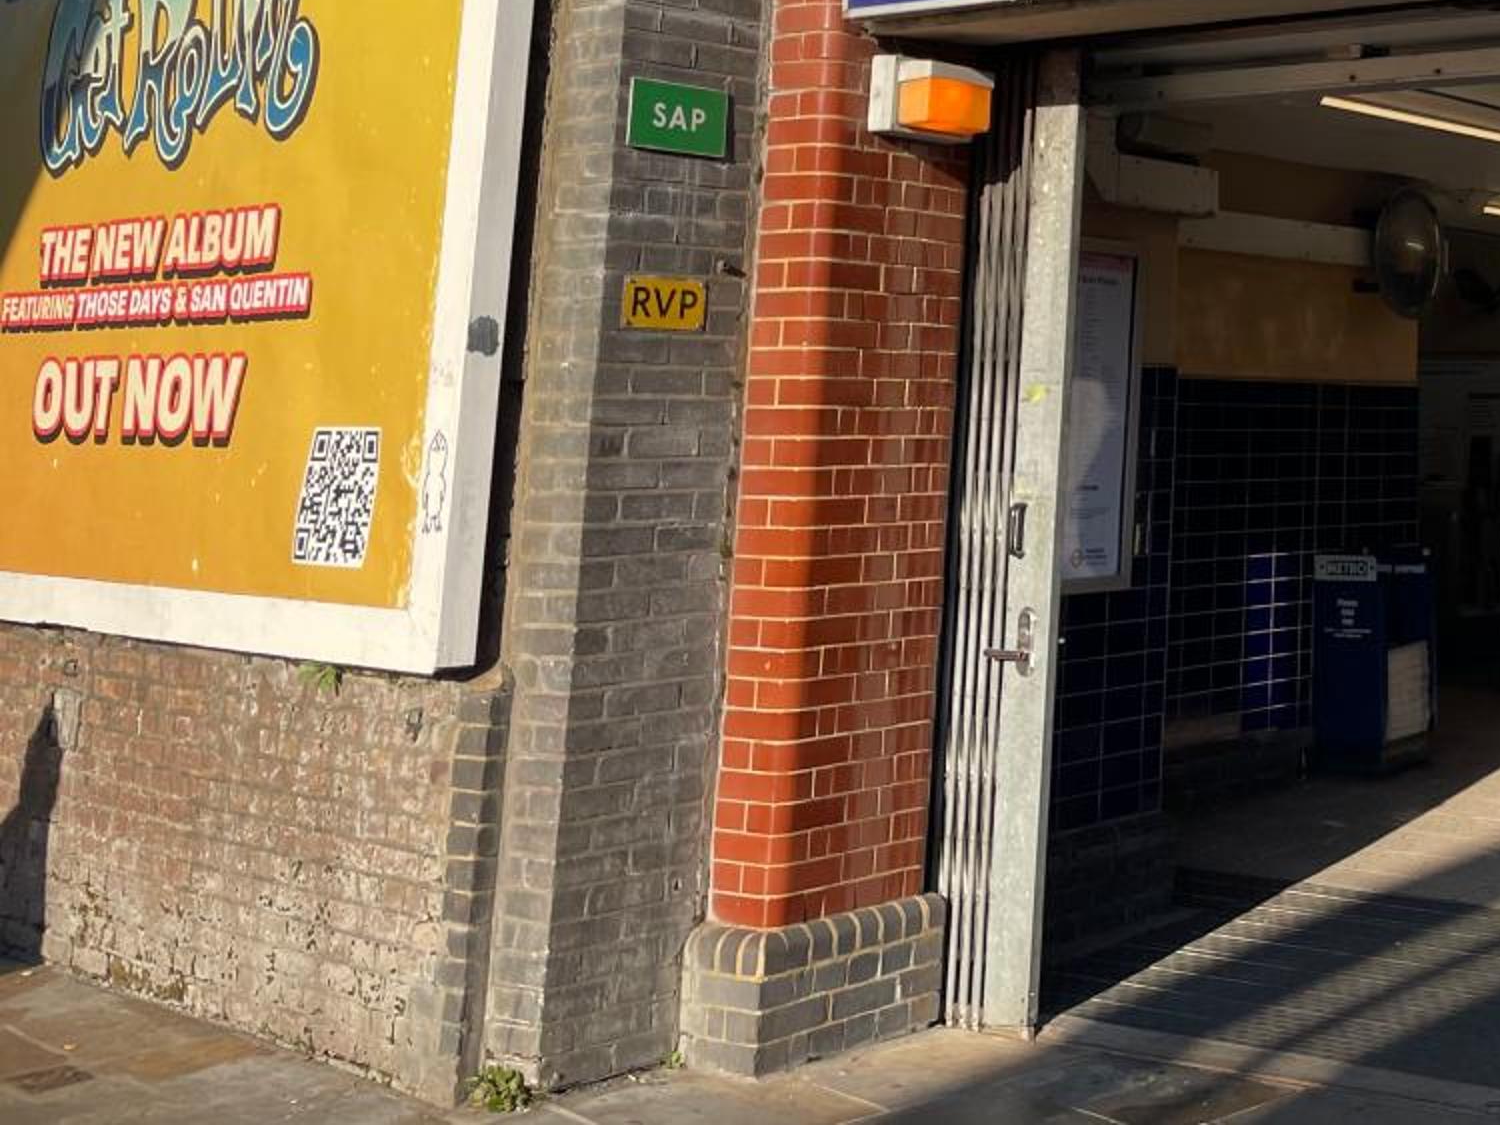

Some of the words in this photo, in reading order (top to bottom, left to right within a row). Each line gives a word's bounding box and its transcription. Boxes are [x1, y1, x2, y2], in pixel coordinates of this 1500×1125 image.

[652, 103, 706, 132] SAP
[40, 225, 92, 286] THE
[92, 216, 167, 283] NEW
[163, 204, 281, 279] ALBUM
[1, 292, 75, 332] FEATURING
[75, 287, 129, 329] THOSE
[128, 283, 173, 325] DAYS
[174, 285, 189, 324] &
[189, 279, 228, 322] SAN
[228, 274, 312, 321] QUENTIN
[632, 285, 698, 319] RVP
[32, 356, 120, 444] OUT
[121, 352, 247, 446] NOW
